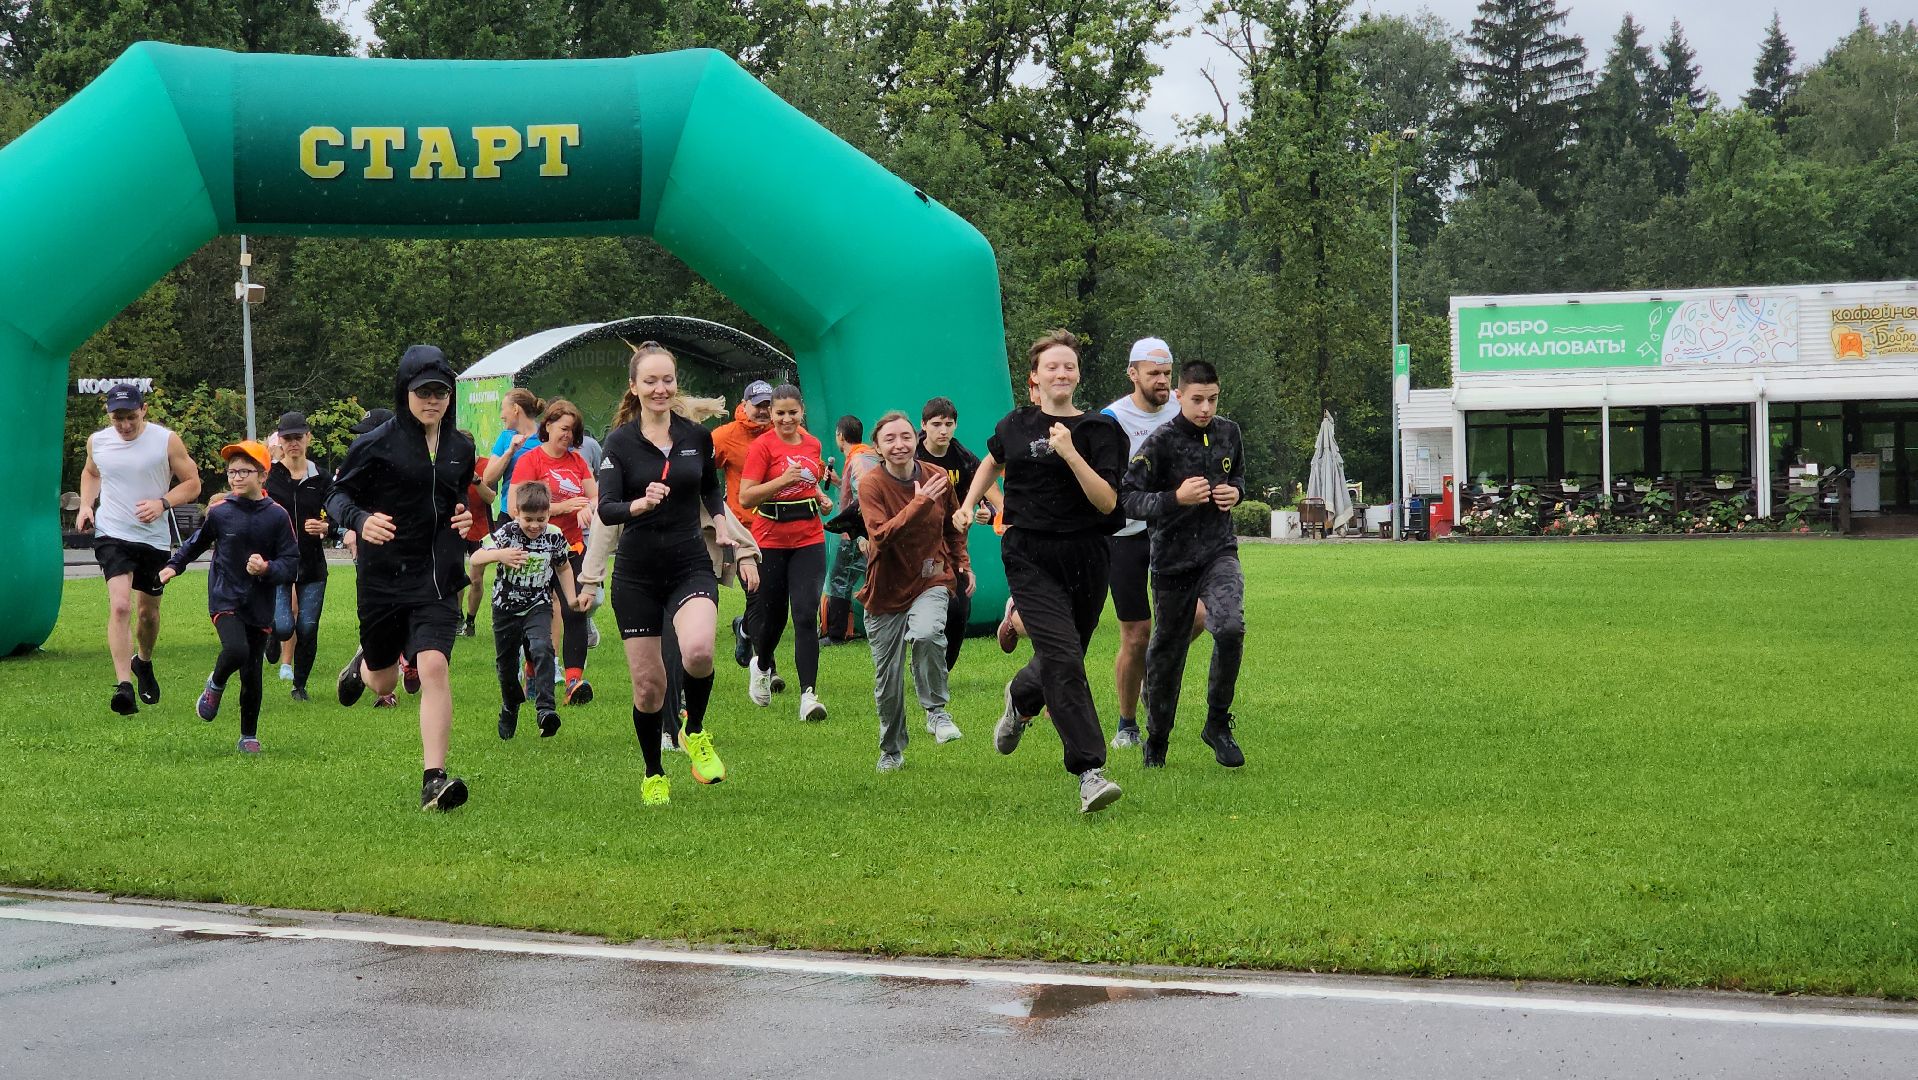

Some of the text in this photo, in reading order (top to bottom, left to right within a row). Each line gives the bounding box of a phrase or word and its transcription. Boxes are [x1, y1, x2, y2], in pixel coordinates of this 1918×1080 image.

[300, 124, 580, 179] СТАРТ
[1478, 319, 1549, 339] ДОБРО
[1479, 339, 1626, 358] ПОЖАЛОВАТЬ!
